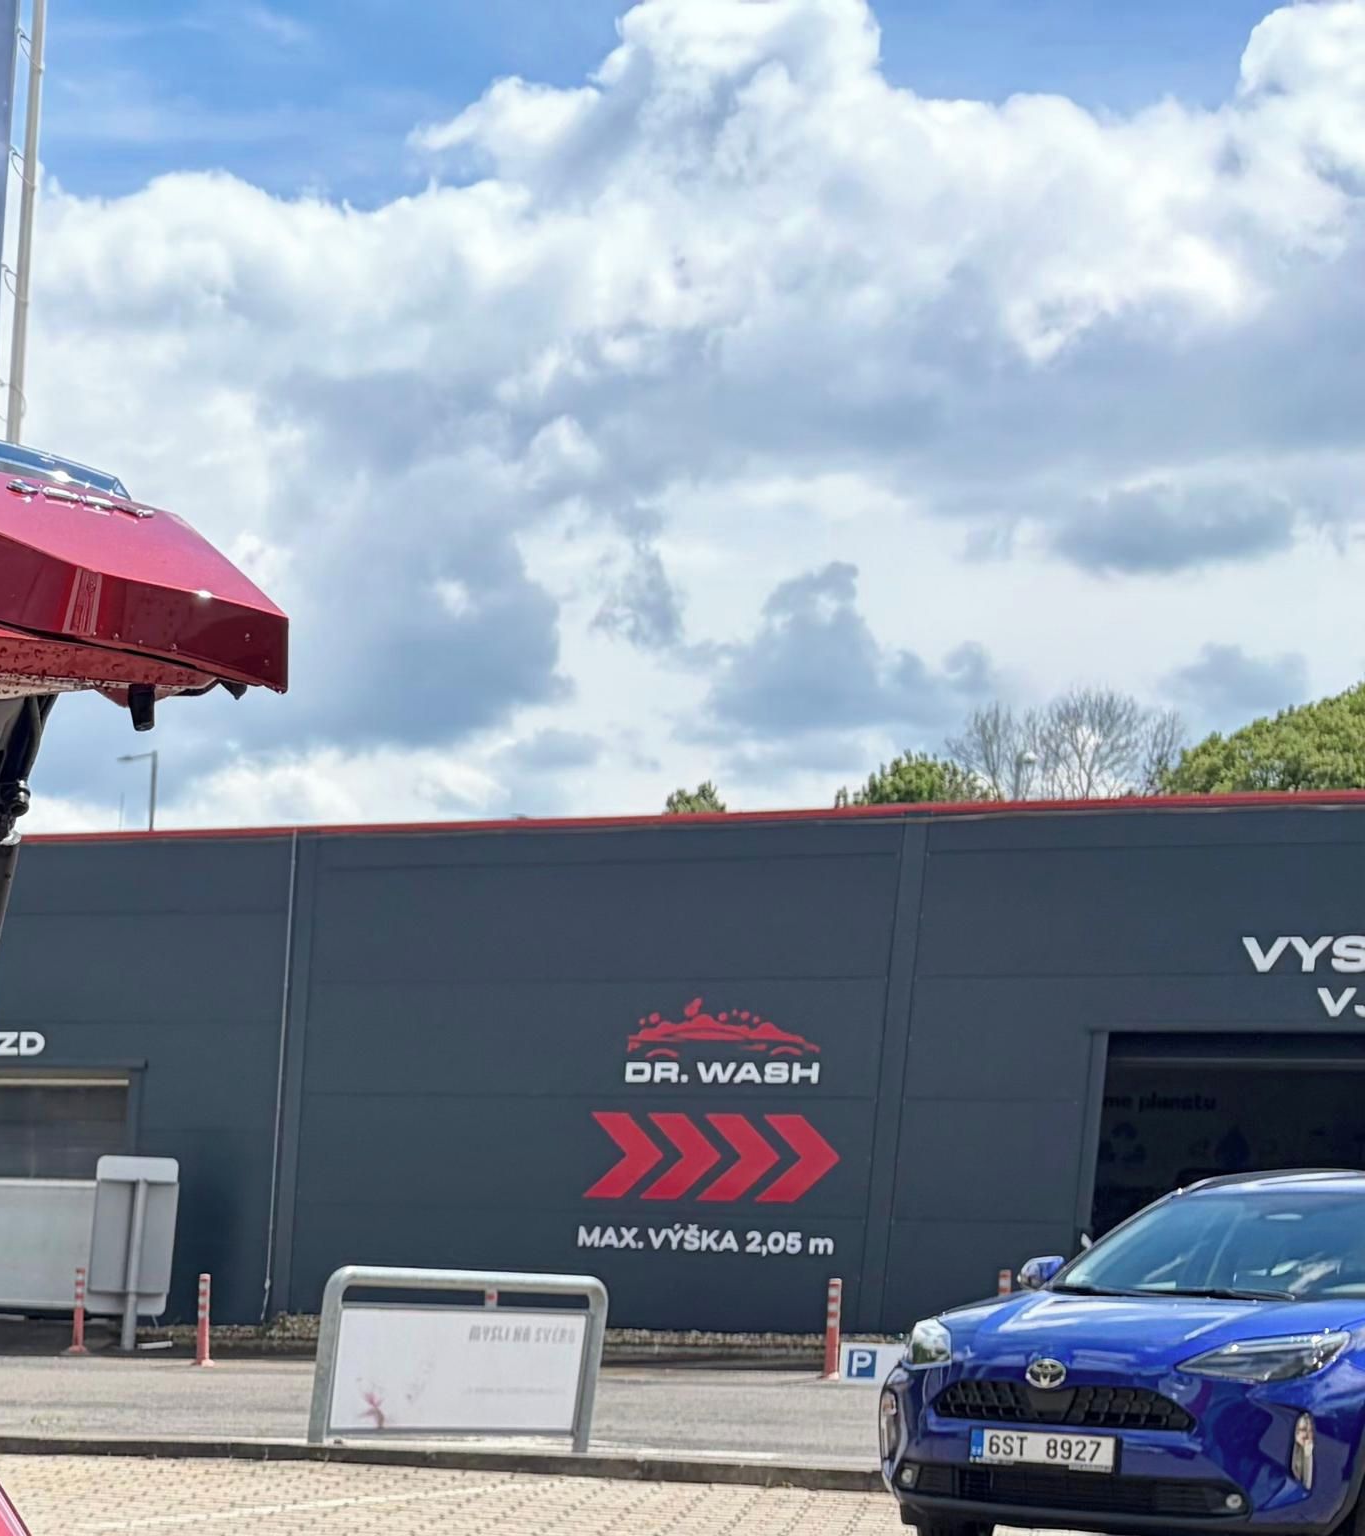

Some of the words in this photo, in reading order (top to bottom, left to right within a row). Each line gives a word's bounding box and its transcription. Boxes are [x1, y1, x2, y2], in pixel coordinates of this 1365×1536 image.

[624, 1061, 689, 1084] DR.
[696, 1061, 820, 1084] WASH
[576, 1225, 644, 1249] MAX.
[647, 1223, 739, 1252] VÝŠKA
[745, 1230, 803, 1257] 2,05
[807, 1234, 835, 1256] m
[851, 1350, 874, 1376] P
[988, 1434, 1028, 1458] 6ST
[1045, 1438, 1103, 1463] 8927
